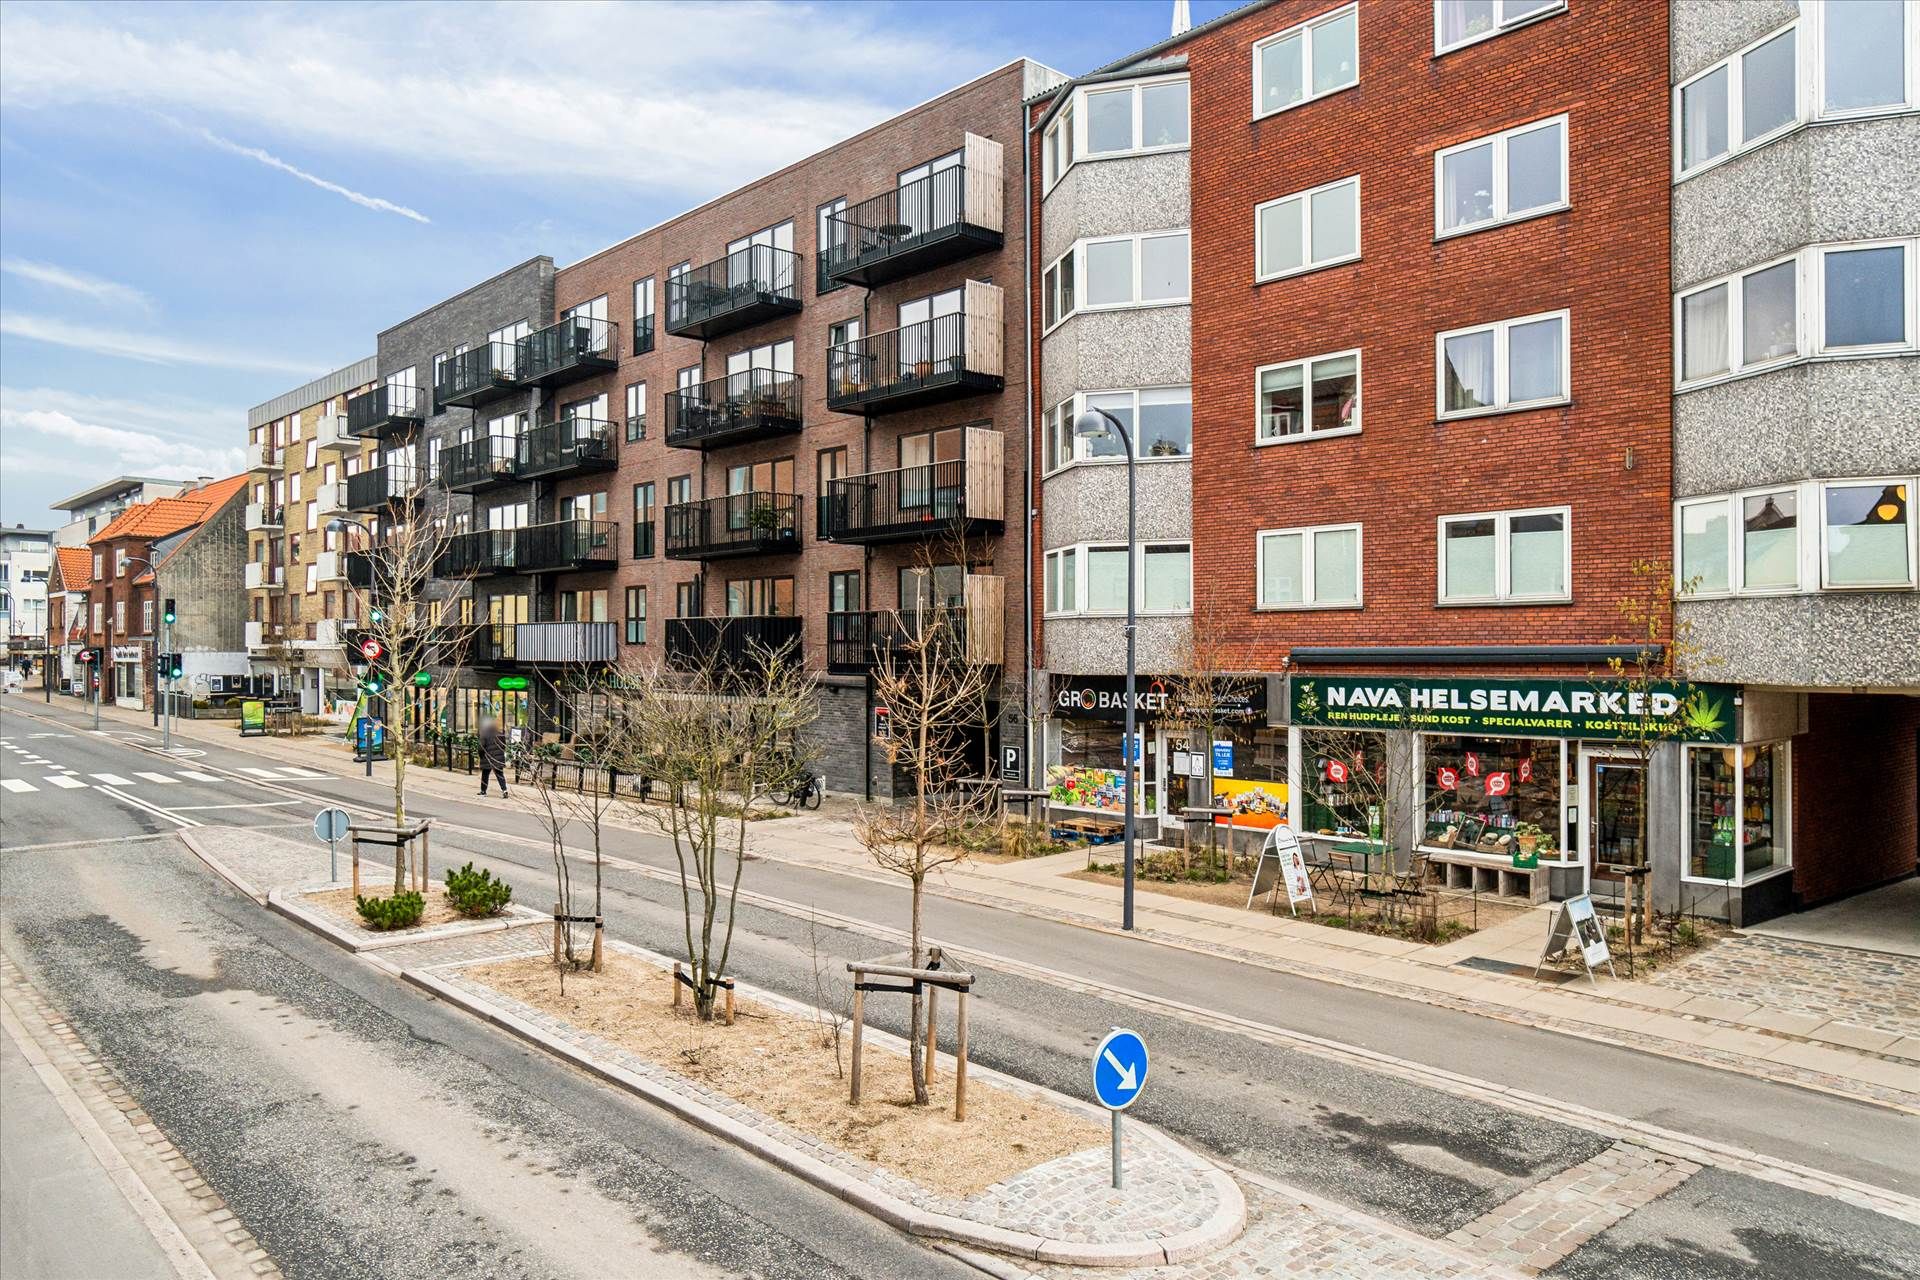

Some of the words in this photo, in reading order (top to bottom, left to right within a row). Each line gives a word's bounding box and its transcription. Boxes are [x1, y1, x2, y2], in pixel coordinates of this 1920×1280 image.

[1327, 686, 1403, 707] NAVA
[1410, 688, 1678, 716] HELSEMARKED
[1327, 711, 1347, 720] REN
[1349, 712, 1400, 722] HUDPLEJE
[1410, 714, 1440, 724] SUND
[1441, 715, 1471, 725] KOST
[1482, 716, 1572, 728] SPECIALVARER
[1175, 738, 1190, 751] 54
[1006, 748, 1017, 769] P
